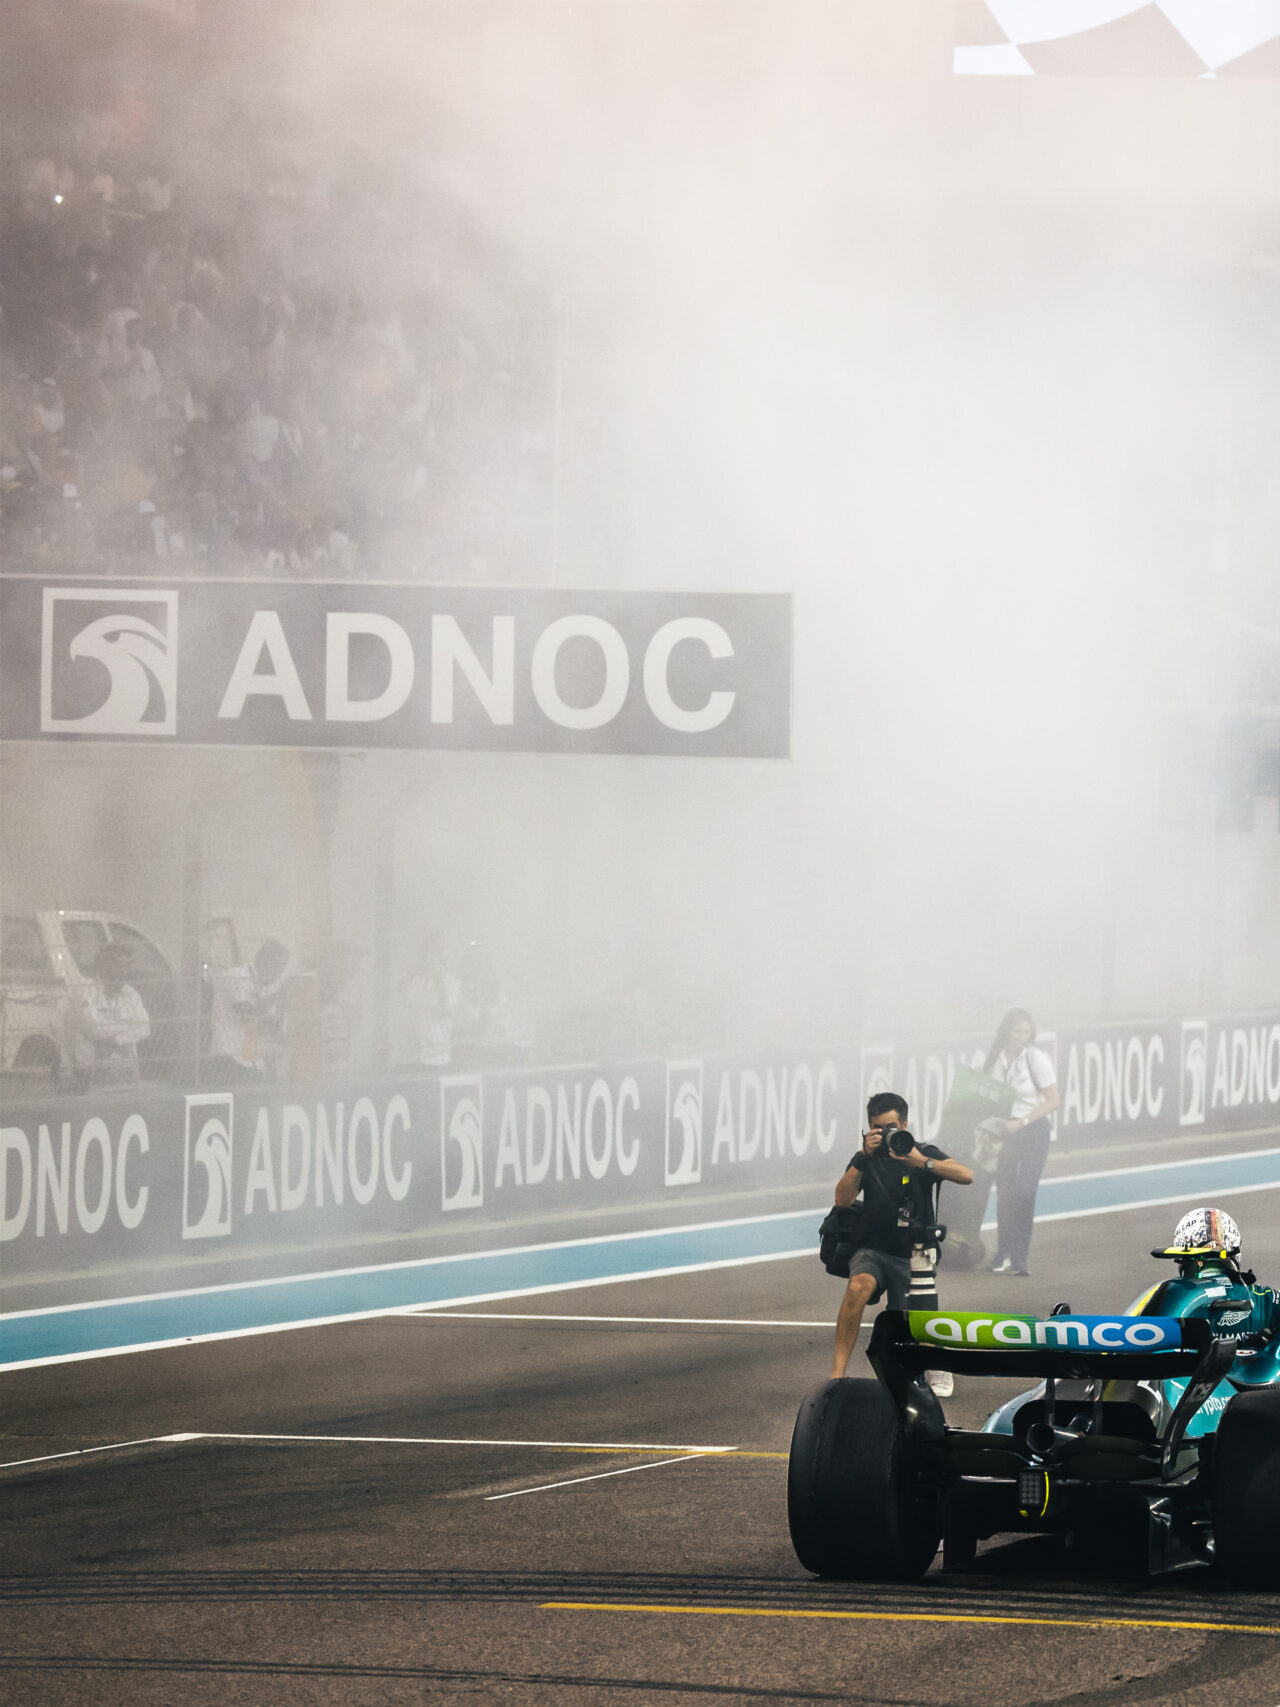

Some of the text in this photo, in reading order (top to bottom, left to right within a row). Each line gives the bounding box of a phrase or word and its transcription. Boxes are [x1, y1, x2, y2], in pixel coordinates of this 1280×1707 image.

[217, 609, 736, 733] ADNOC
[495, 1076, 641, 1188] ADNOC
[712, 1061, 838, 1165] ADNOC
[1063, 1034, 1164, 1126] ADNOC
[244, 1094, 413, 1214] ADNOC
[925, 1317, 1165, 1347] aramco
